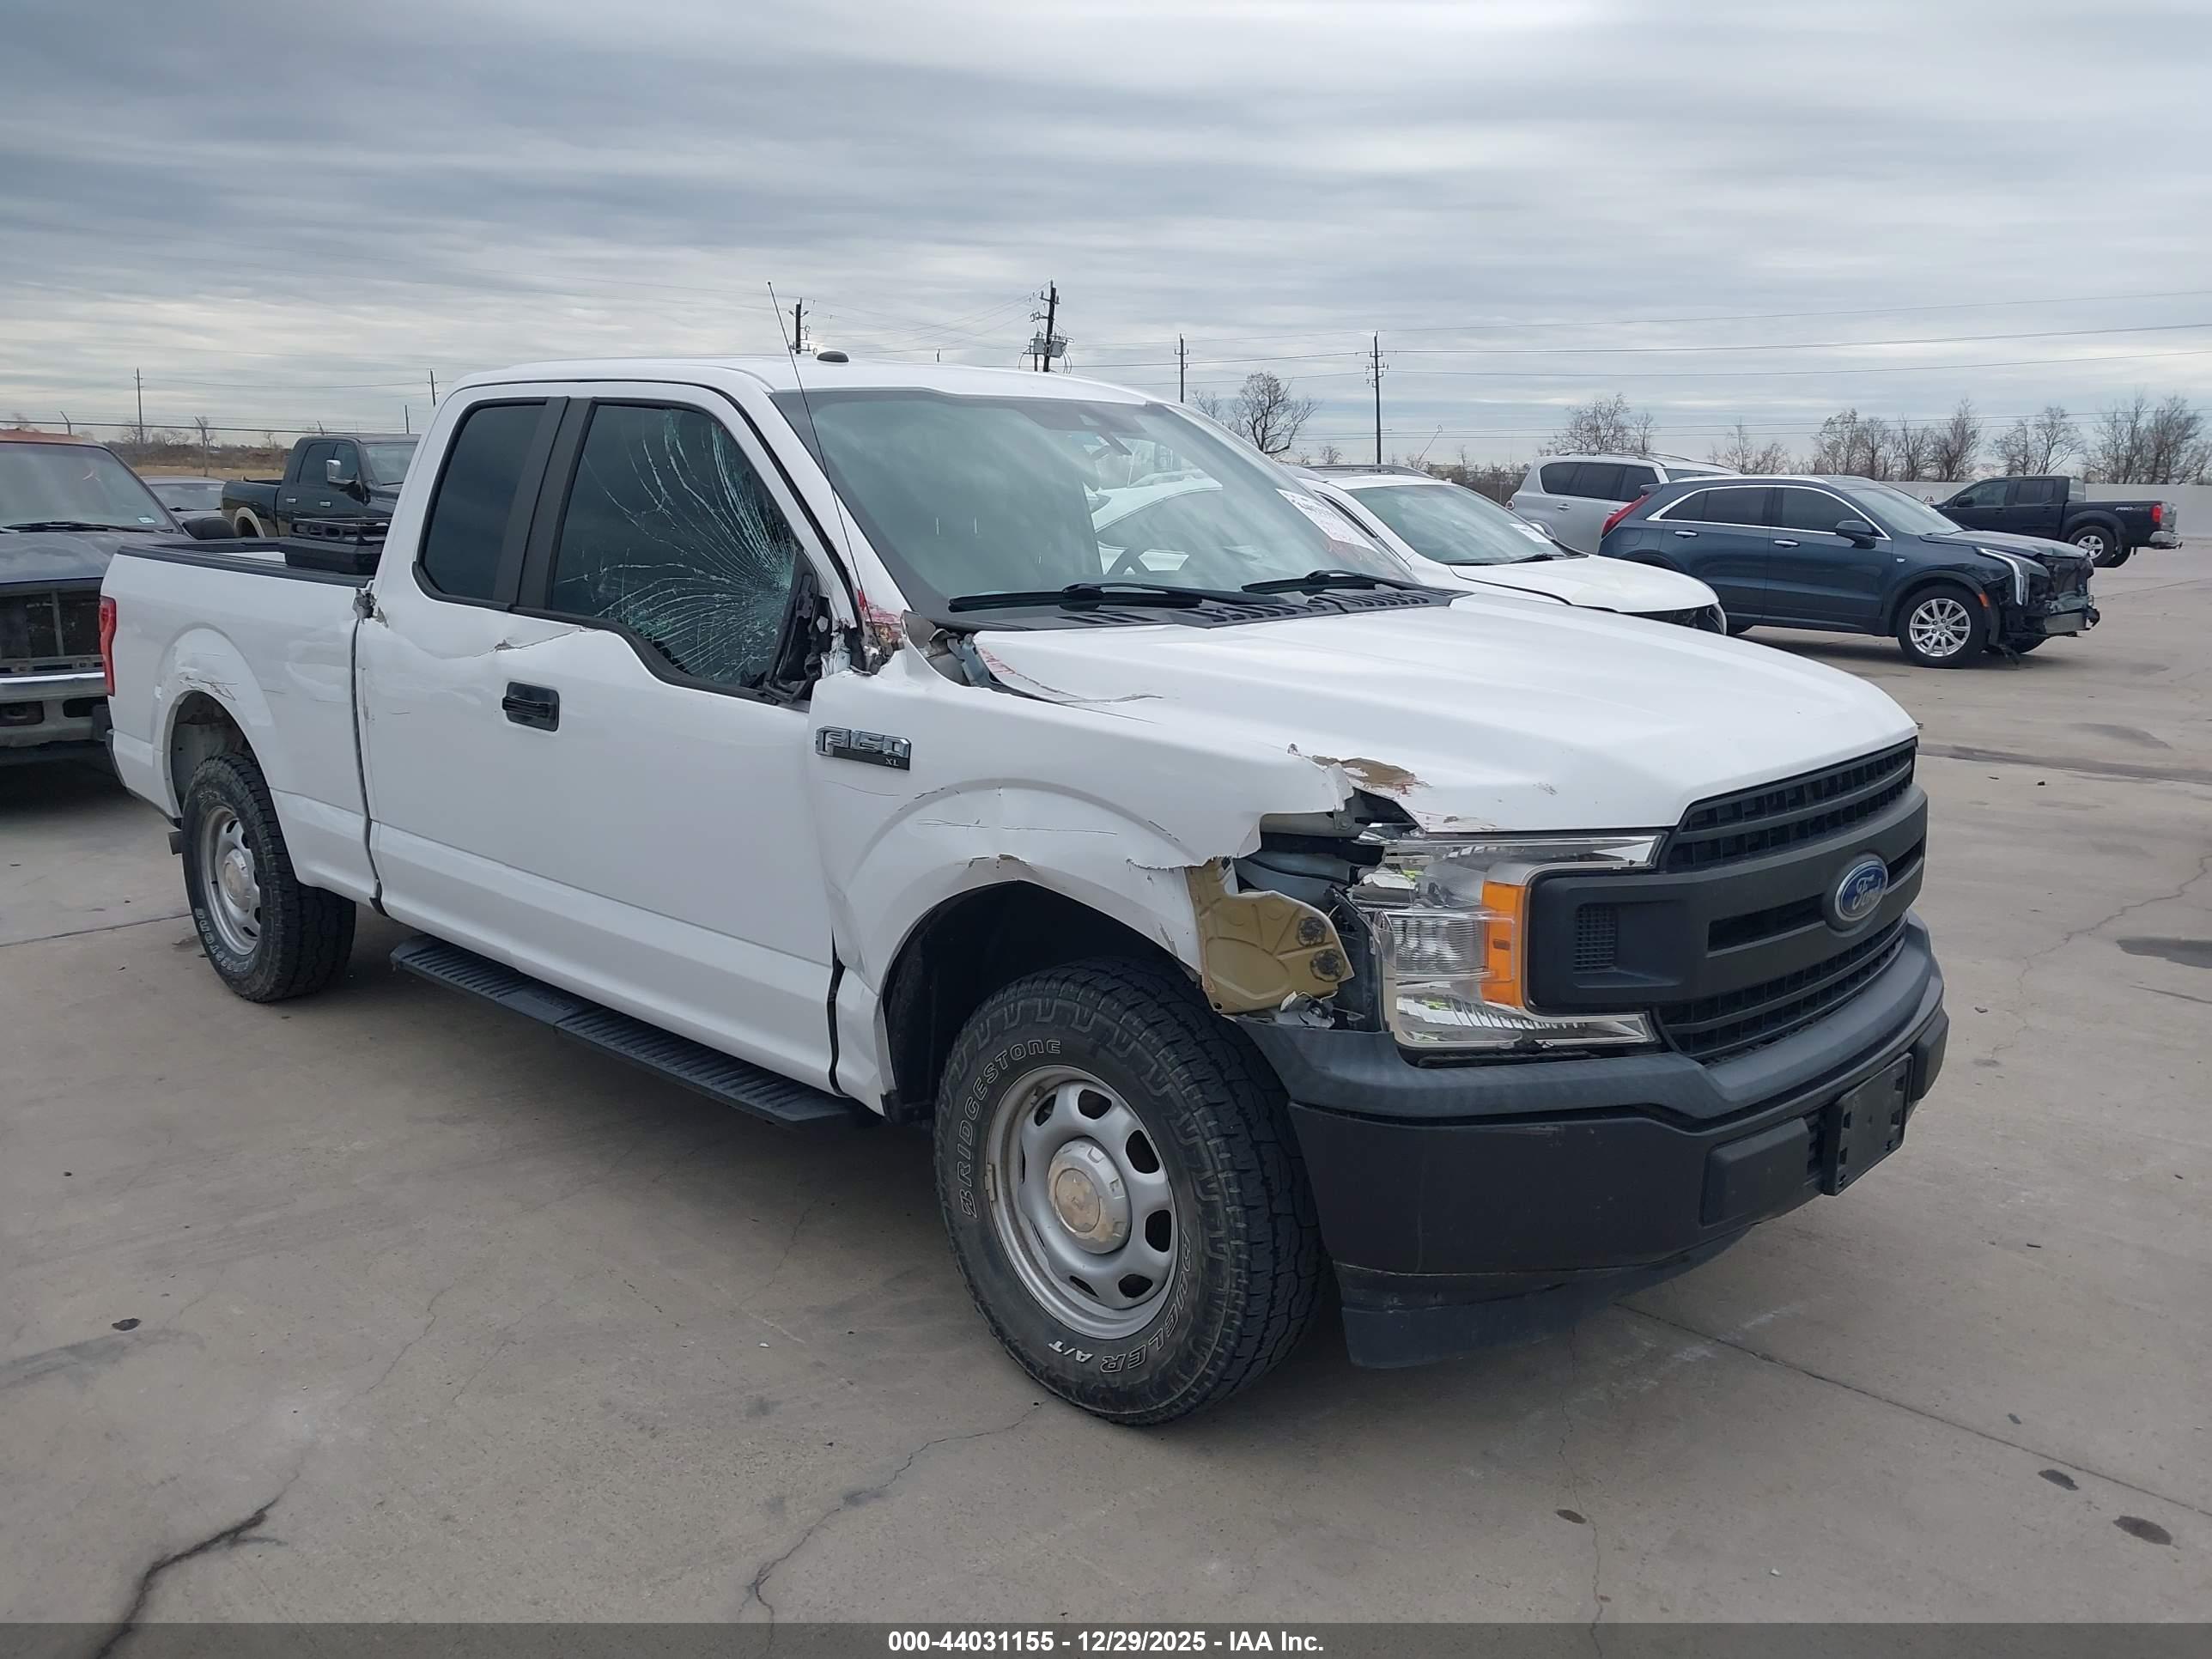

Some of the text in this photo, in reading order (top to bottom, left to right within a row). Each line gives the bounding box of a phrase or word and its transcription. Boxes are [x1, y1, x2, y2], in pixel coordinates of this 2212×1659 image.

[885, 757, 899, 767] XL
[1851, 874, 1882, 910] Ford
[957, 1039, 1061, 1219] BRIDGESTONE
[1048, 1229, 1192, 1373] DUELER A/T
